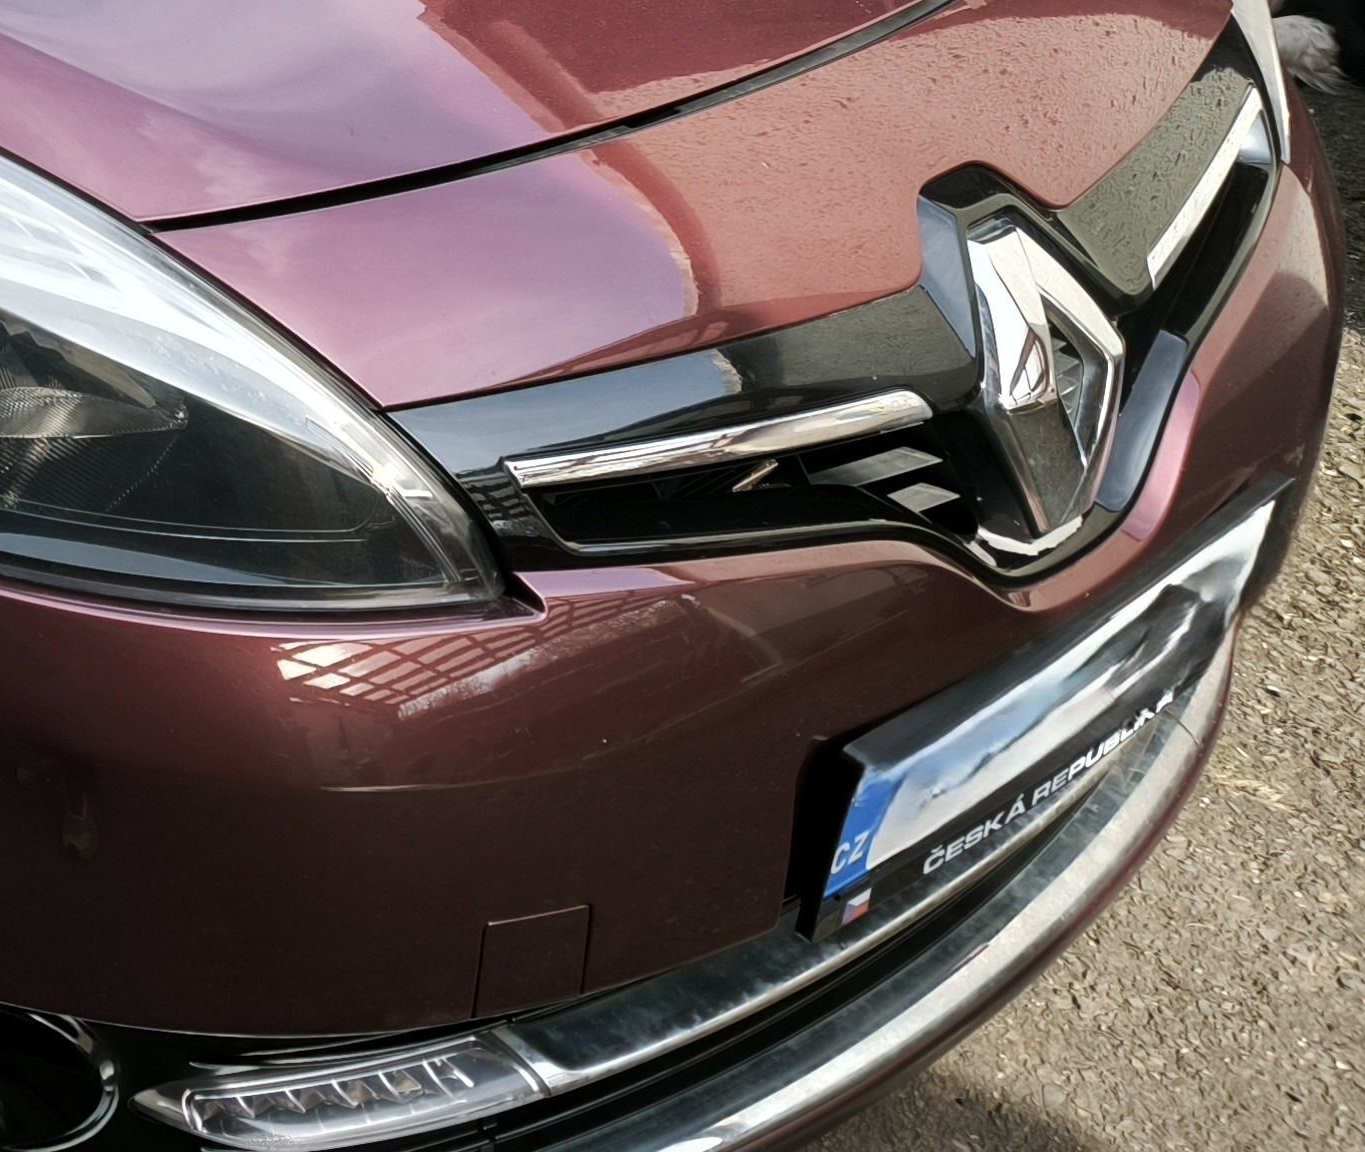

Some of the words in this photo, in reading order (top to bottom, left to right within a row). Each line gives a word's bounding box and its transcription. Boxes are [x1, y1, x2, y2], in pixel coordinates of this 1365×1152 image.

[922, 793, 1027, 876] ČESKÁ
[1031, 689, 1174, 805] REPUBLIKA
[830, 832, 868, 875] CZ
